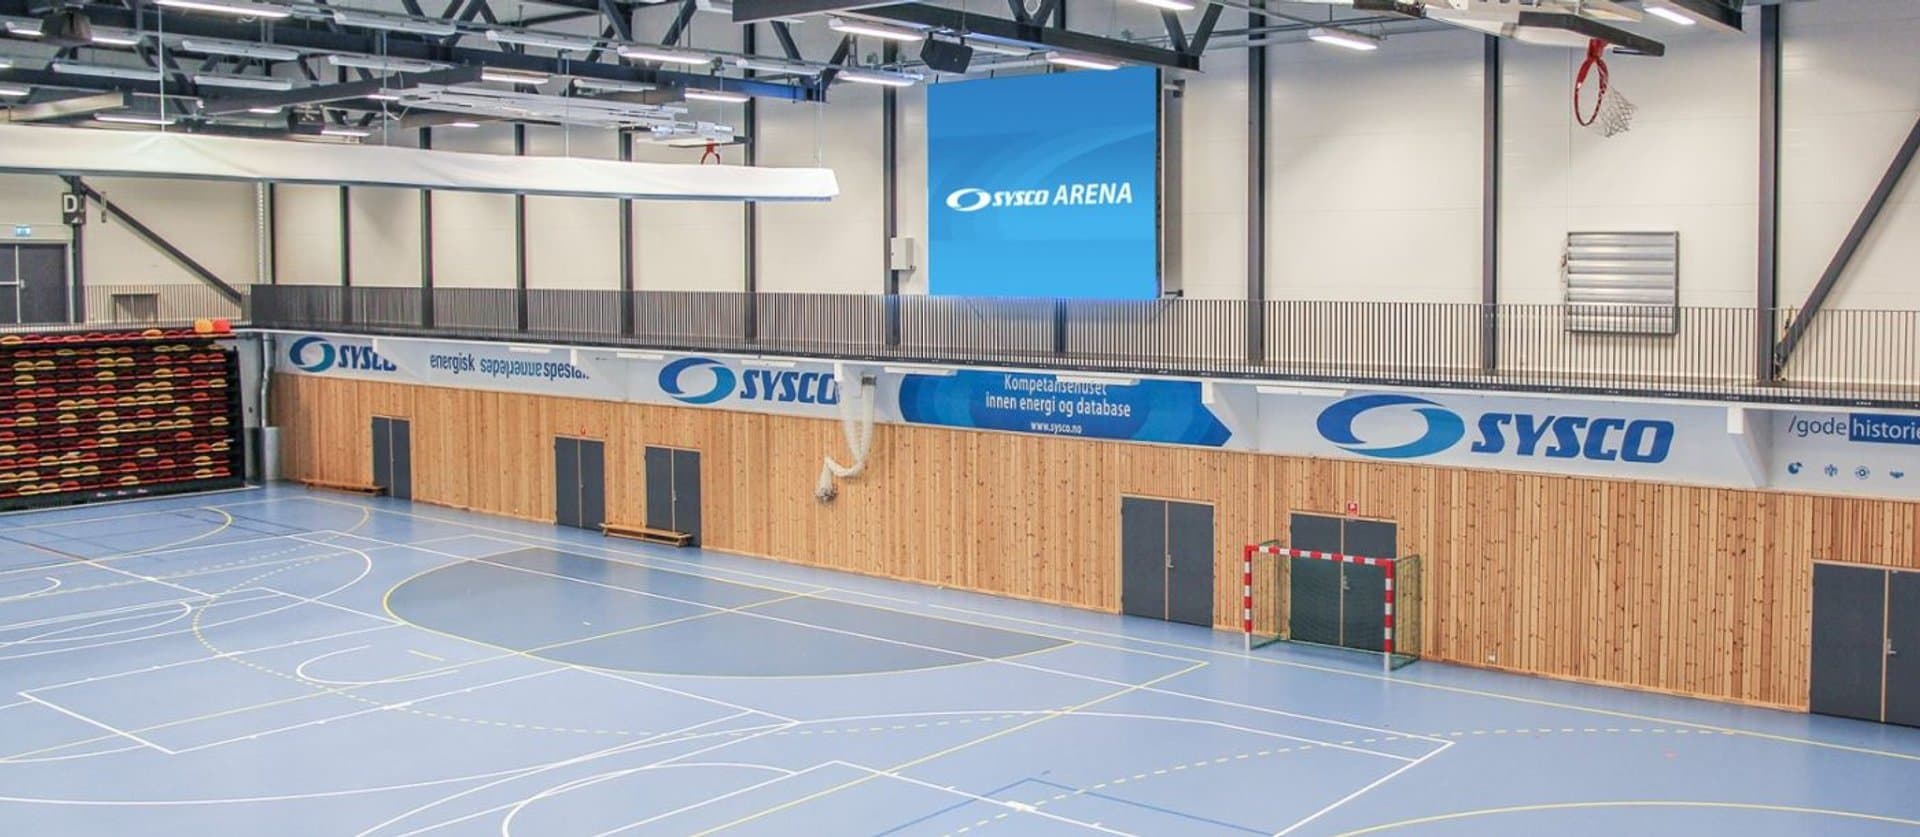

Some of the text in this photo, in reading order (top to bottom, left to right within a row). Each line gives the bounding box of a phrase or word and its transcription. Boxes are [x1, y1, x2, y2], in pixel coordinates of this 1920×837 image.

[63, 194, 78, 213] D
[992, 182, 1133, 207] SYSCO ARENA
[429, 352, 476, 375] energisk
[985, 391, 1131, 418] innen energi og database
[1030, 421, 1083, 435] www.sysco.no
[1471, 412, 1675, 464] SYSCO
[1788, 415, 1847, 438] /gode
